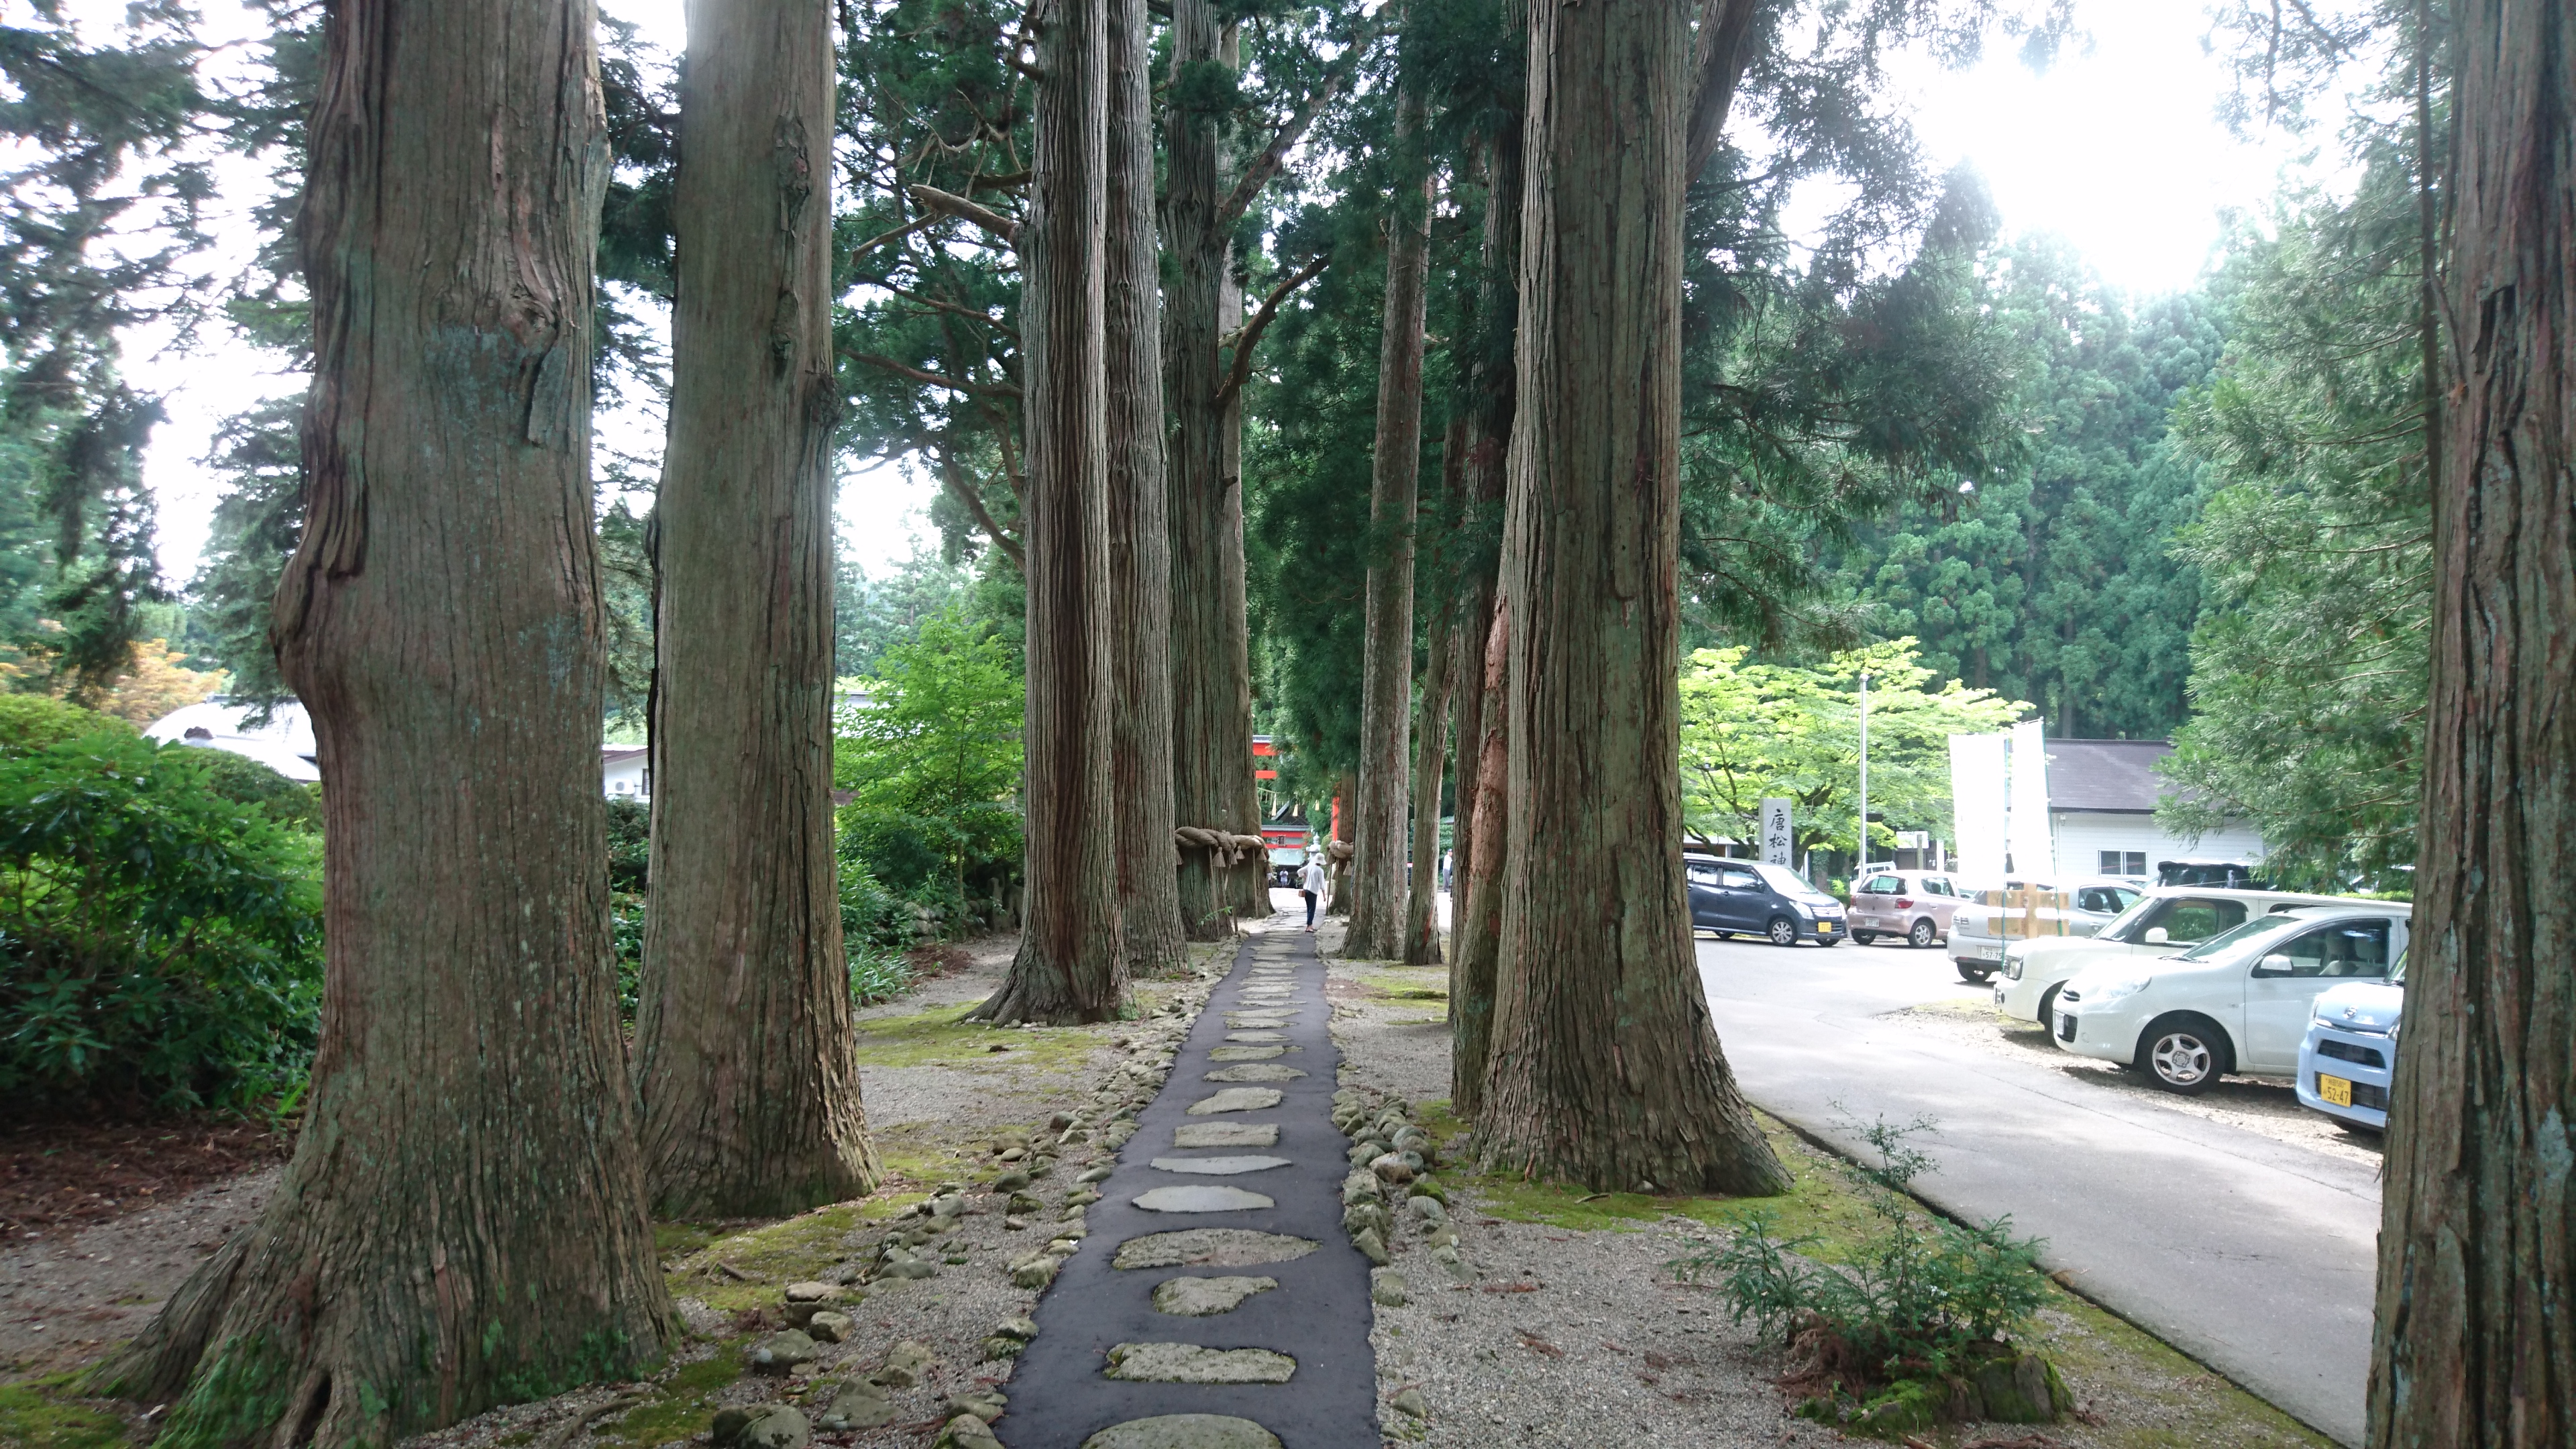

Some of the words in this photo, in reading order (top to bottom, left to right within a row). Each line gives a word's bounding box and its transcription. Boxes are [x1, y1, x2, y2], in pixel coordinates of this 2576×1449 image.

[1768, 808, 1788, 865] 唐松神
[2328, 1086, 2349, 1104] 52-47
